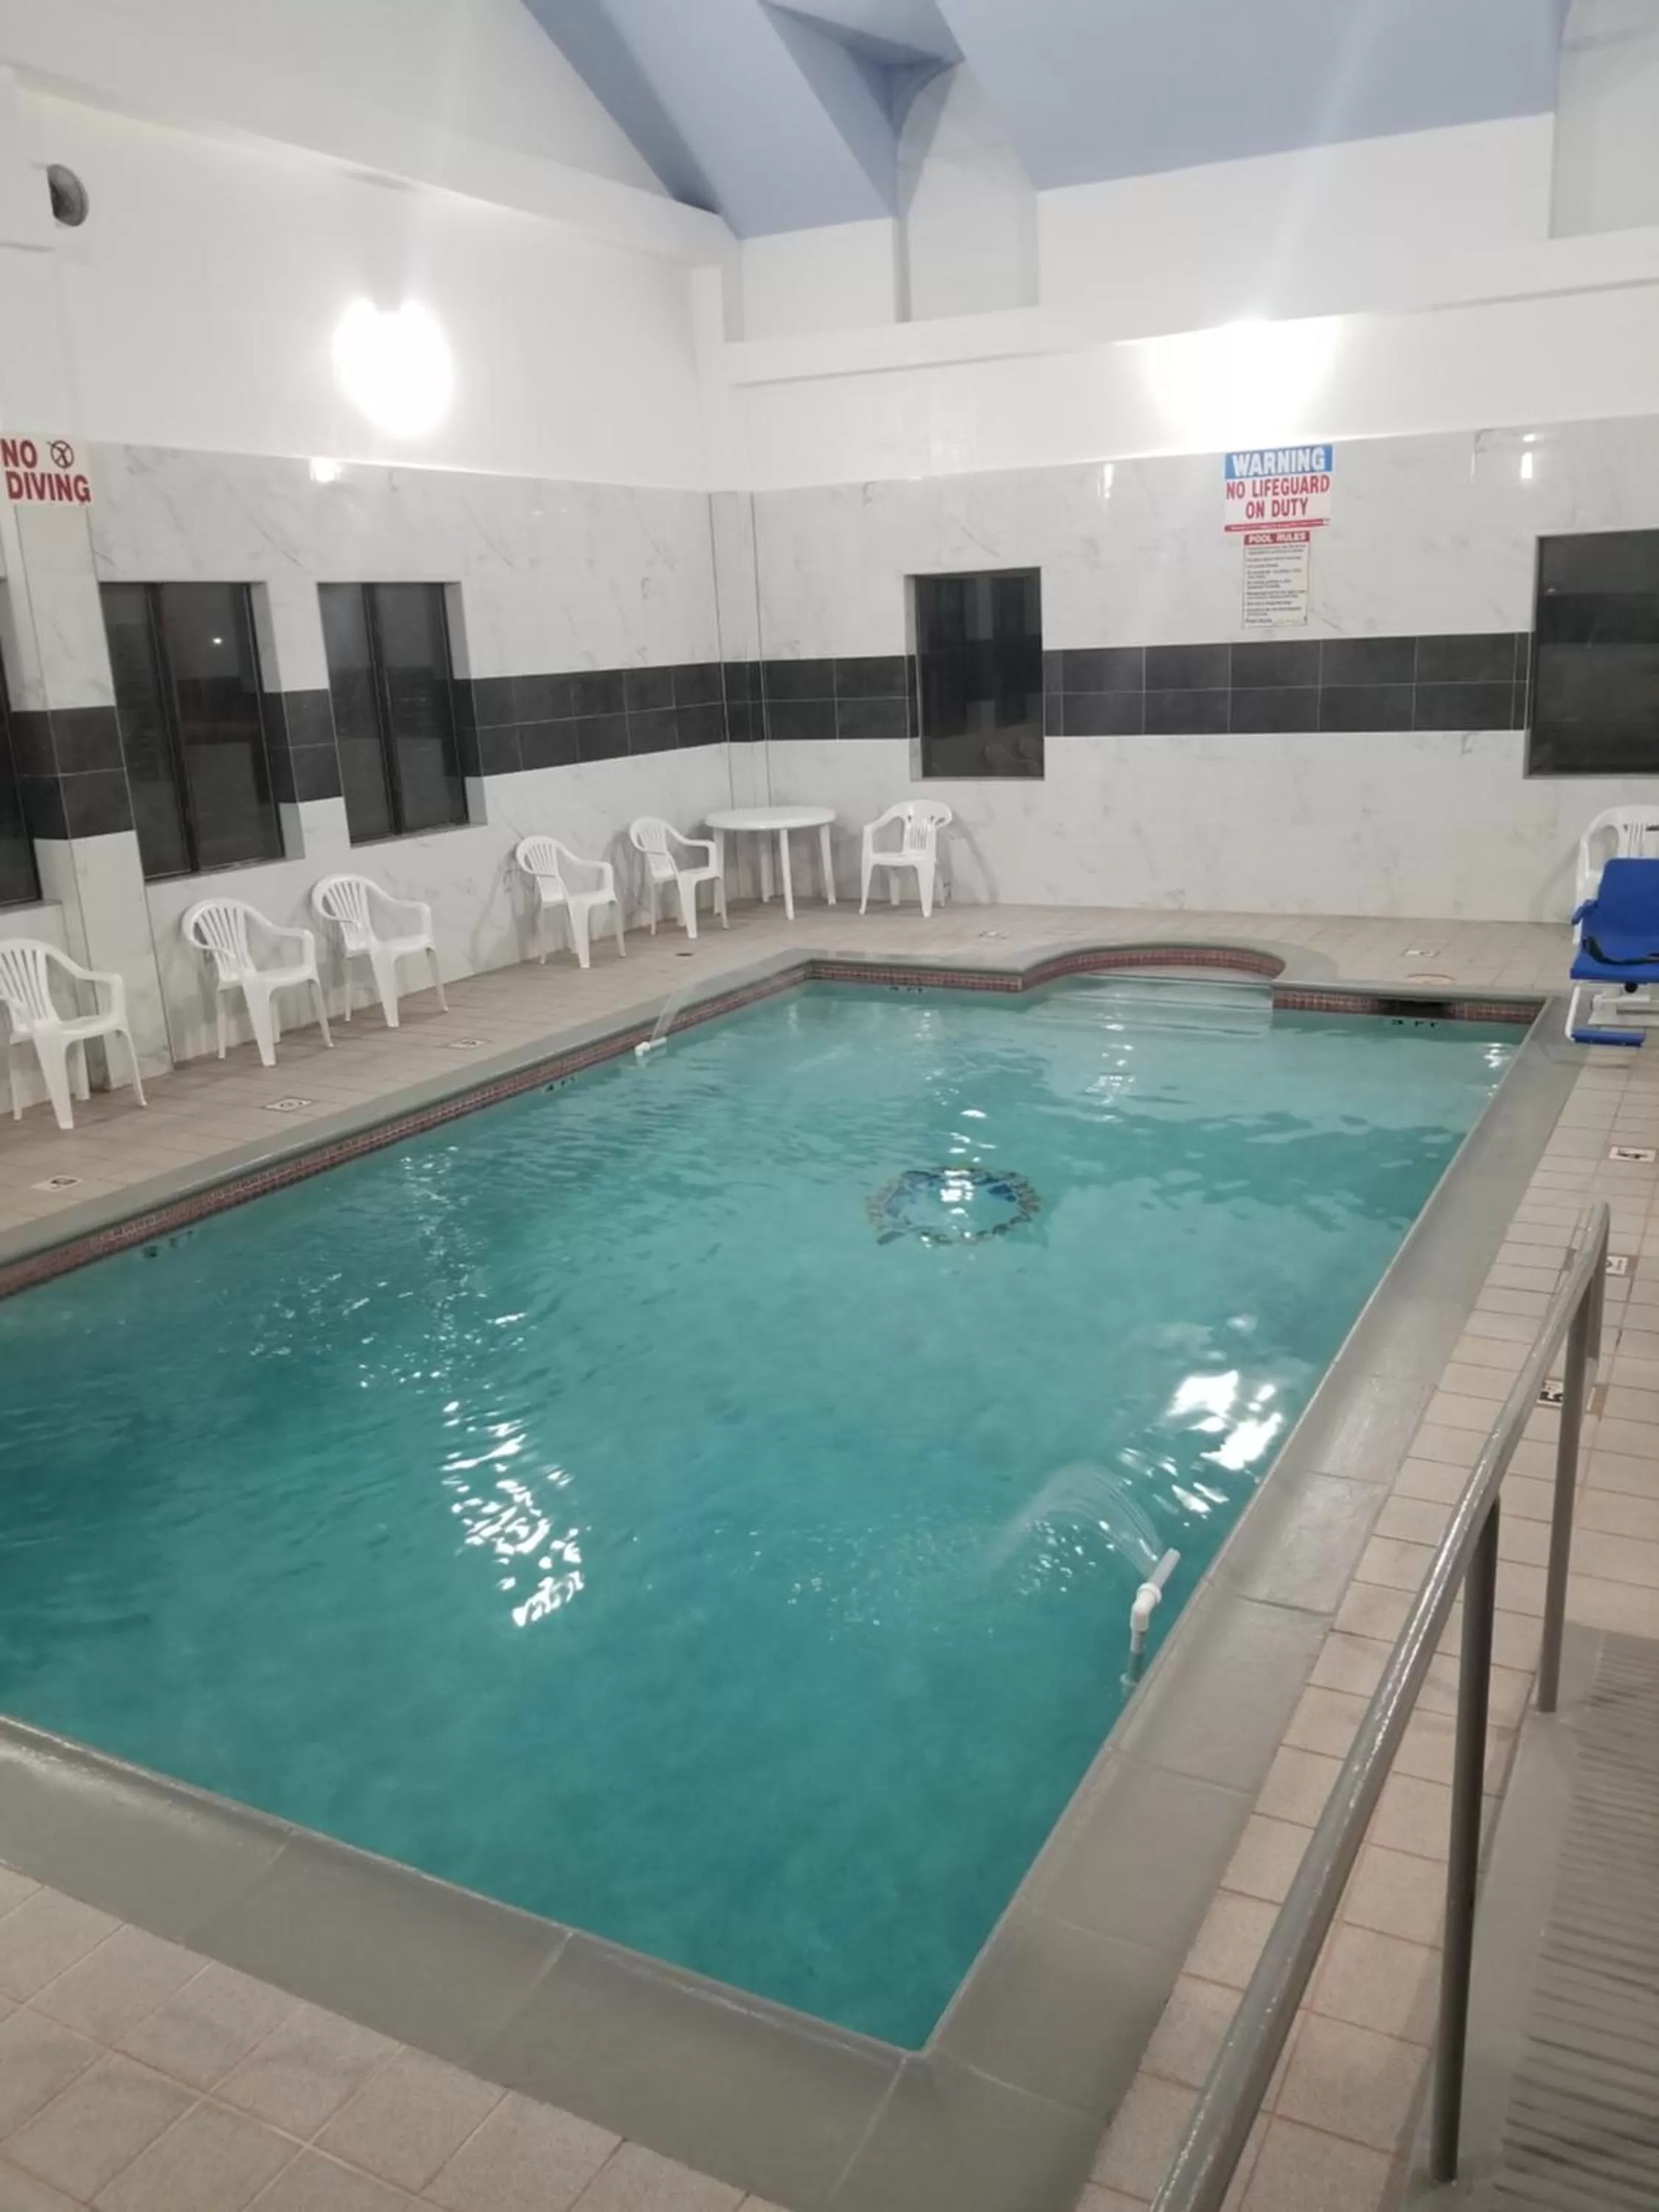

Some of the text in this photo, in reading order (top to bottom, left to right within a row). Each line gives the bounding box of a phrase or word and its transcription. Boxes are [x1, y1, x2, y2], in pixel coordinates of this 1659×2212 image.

[0, 438, 38, 468] NO
[1232, 446, 1326, 477] WARNING
[6, 470, 91, 502] DIVING
[1226, 474, 1330, 500] NO LIFEGUARD
[1245, 498, 1310, 519] ON DUTY
